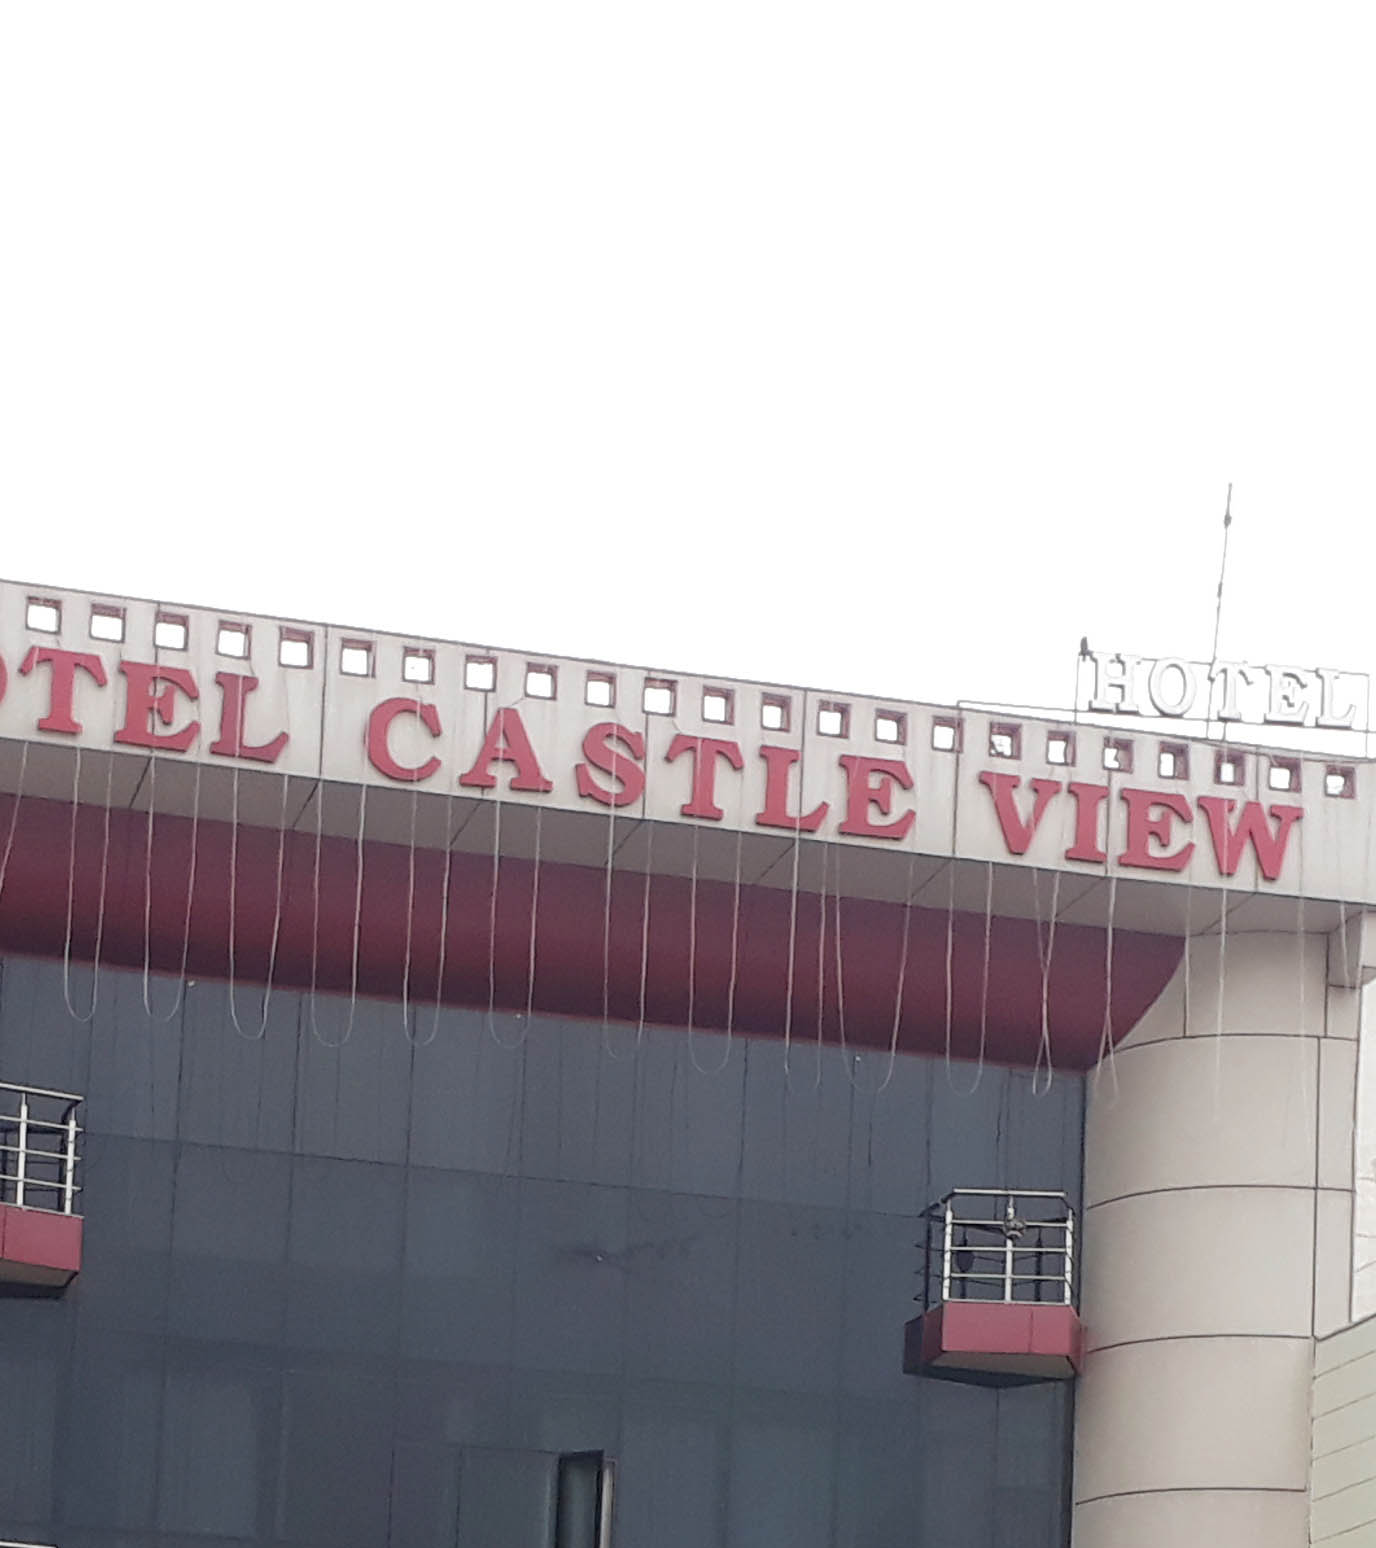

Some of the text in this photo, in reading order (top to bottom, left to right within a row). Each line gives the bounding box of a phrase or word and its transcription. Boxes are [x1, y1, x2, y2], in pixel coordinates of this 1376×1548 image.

[1087, 653, 1358, 729] HOTEL
[363, 696, 917, 842] CASTLE
[978, 770, 1305, 882] VIEW
